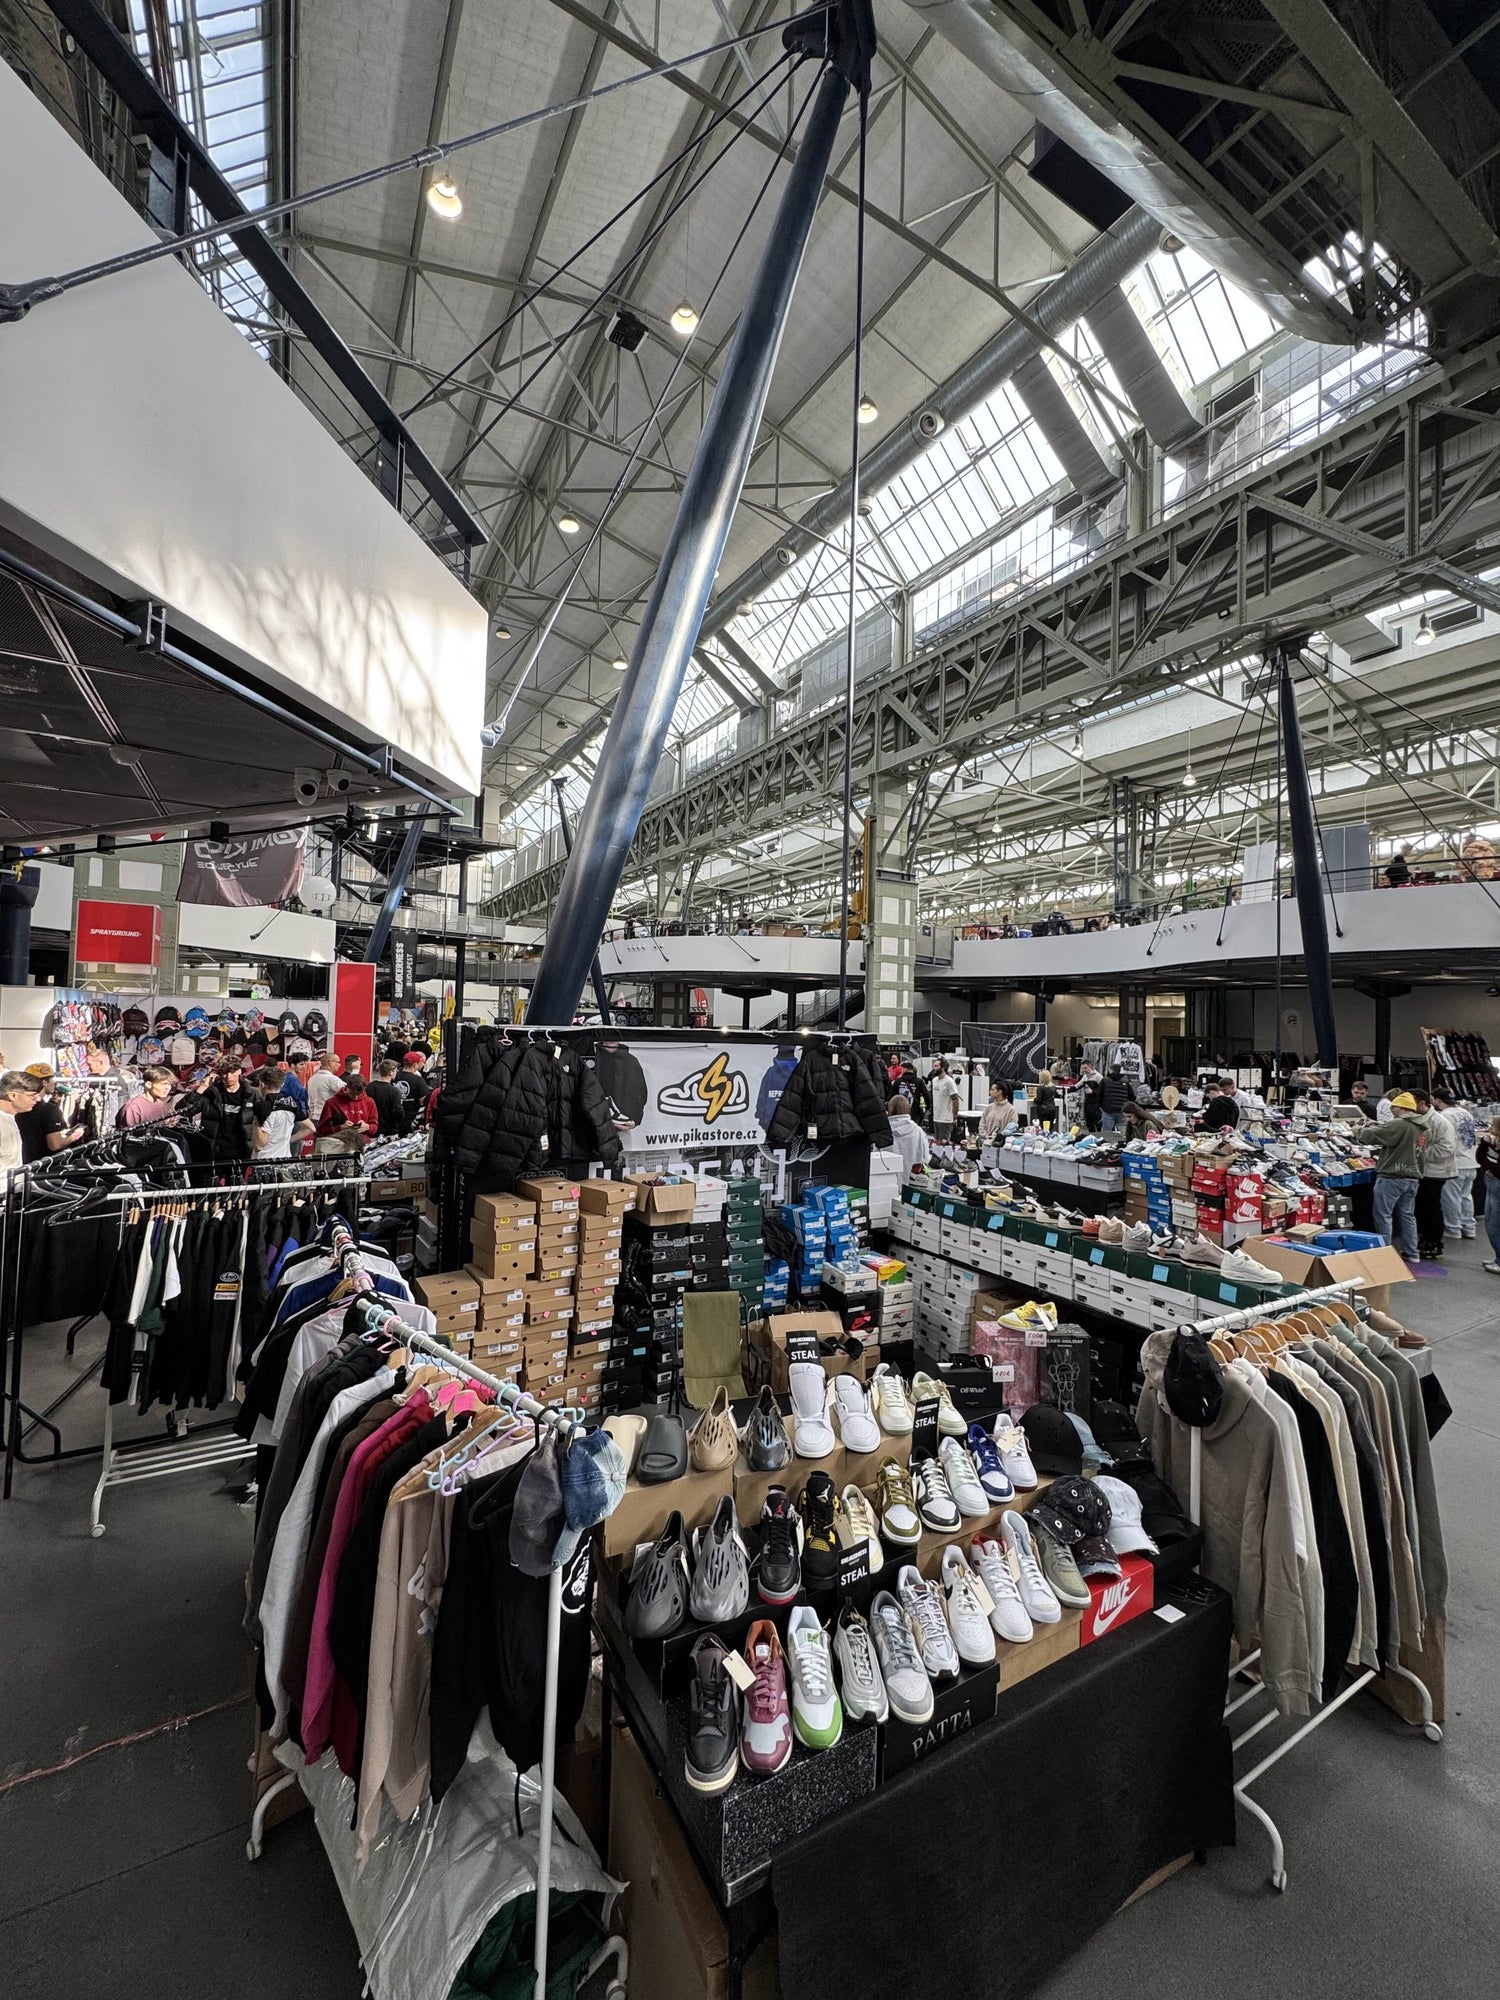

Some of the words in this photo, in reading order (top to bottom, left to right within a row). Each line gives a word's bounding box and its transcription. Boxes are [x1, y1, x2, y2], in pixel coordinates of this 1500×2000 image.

[89, 928, 141, 938] SPRAYGROUND
[394, 942, 404, 998] SNEAKERNESS
[645, 1128, 758, 1146] www.pikastore.cz
[1239, 1177, 1260, 1195] NIKE
[1239, 1201, 1260, 1218] NIKE
[791, 1350, 818, 1360] STEAL
[915, 1416, 936, 1428] STEAL
[840, 1566, 868, 1586] STEAL
[1100, 1577, 1131, 1615] NIKE
[912, 1709, 972, 1759] PATTA
